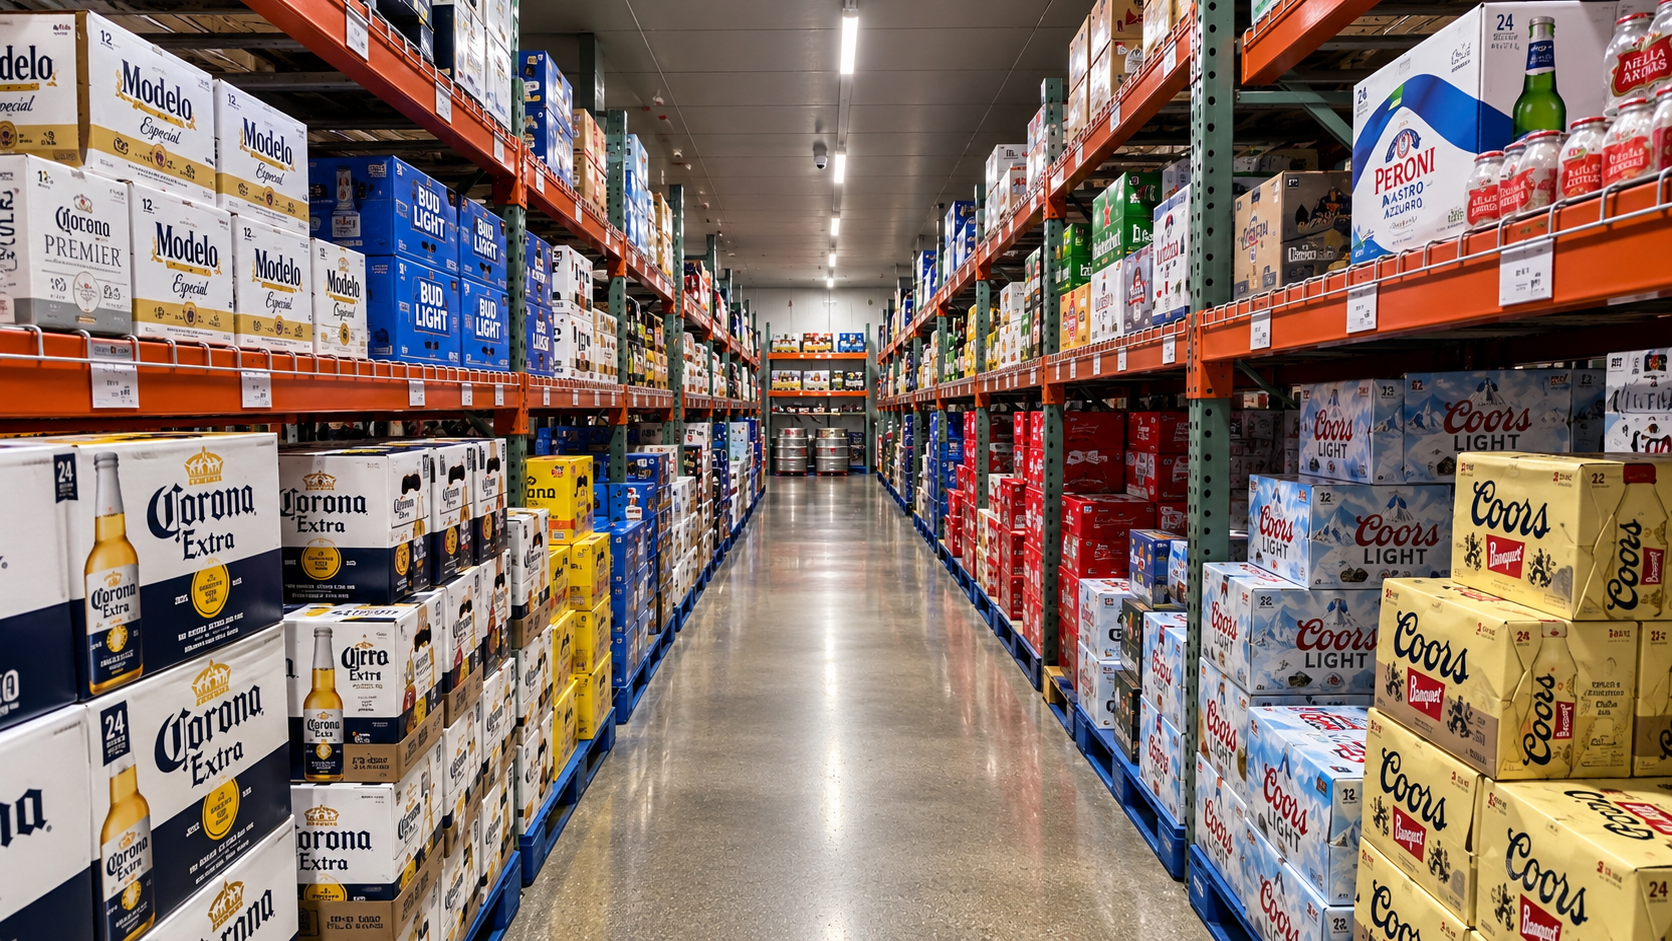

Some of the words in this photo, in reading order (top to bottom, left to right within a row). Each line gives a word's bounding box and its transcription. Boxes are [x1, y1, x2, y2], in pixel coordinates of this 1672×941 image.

[100, 30, 112, 46] 12
[1497, 14, 1513, 30] 24
[121, 59, 193, 121] Modelo
[227, 93, 236, 106] 12
[243, 117, 294, 167] Modelo
[1374, 146, 1436, 196] PERONI
[142, 198, 153, 213] 12
[418, 182, 440, 214] BUD
[243, 227, 252, 240] 12
[413, 204, 446, 239] LIGHT
[44, 234, 122, 268] PREMIER
[155, 222, 218, 269] Modelo
[254, 248, 302, 288] Modelo
[326, 269, 361, 299] Modelo
[172, 273, 209, 299] Especial
[420, 279, 443, 308] BUD
[415, 302, 448, 332] LIGHT
[479, 297, 497, 318] BUD
[475, 314, 501, 341] LIGHT
[1314, 408, 1353, 442] Coors
[1443, 399, 1533, 435] Coors
[1317, 441, 1348, 459] LIGHT
[1454, 434, 1521, 451] LIGHT
[57, 461, 73, 482] 24
[1592, 473, 1605, 484] 22
[147, 483, 255, 543] Corona
[279, 487, 368, 521] Corona
[1471, 480, 1551, 539] Coors
[296, 516, 346, 533] Extra
[1259, 504, 1294, 544] Coors
[1355, 513, 1440, 548] Coors
[183, 528, 235, 561] Extra
[1262, 537, 1289, 560] LIGHT
[1363, 548, 1428, 565] LIGHT
[1607, 519, 1642, 611] Coors
[91, 581, 137, 610] Corona
[103, 602, 130, 619] Extra
[1211, 601, 1239, 641] Coors
[1296, 618, 1379, 651] Coors
[1214, 632, 1234, 656] LIGHT
[1305, 652, 1369, 669] LIGHT
[1394, 610, 1470, 685] Coors
[1409, 675, 1443, 710] Banquet
[105, 709, 125, 740] 24
[154, 684, 264, 773] Corona
[1207, 698, 1238, 752] Coors
[1523, 673, 1556, 766] Coors
[191, 740, 244, 789] Extra
[1209, 732, 1234, 771] LIGHT
[1264, 763, 1309, 836] Coors
[1380, 747, 1448, 831] Coors
[294, 826, 373, 852] orona
[1204, 797, 1233, 855] Coors
[1267, 808, 1301, 853] LIGHT
[299, 851, 349, 871] Extra
[1506, 827, 1589, 926] Coors
[1649, 881, 1668, 898] 24
